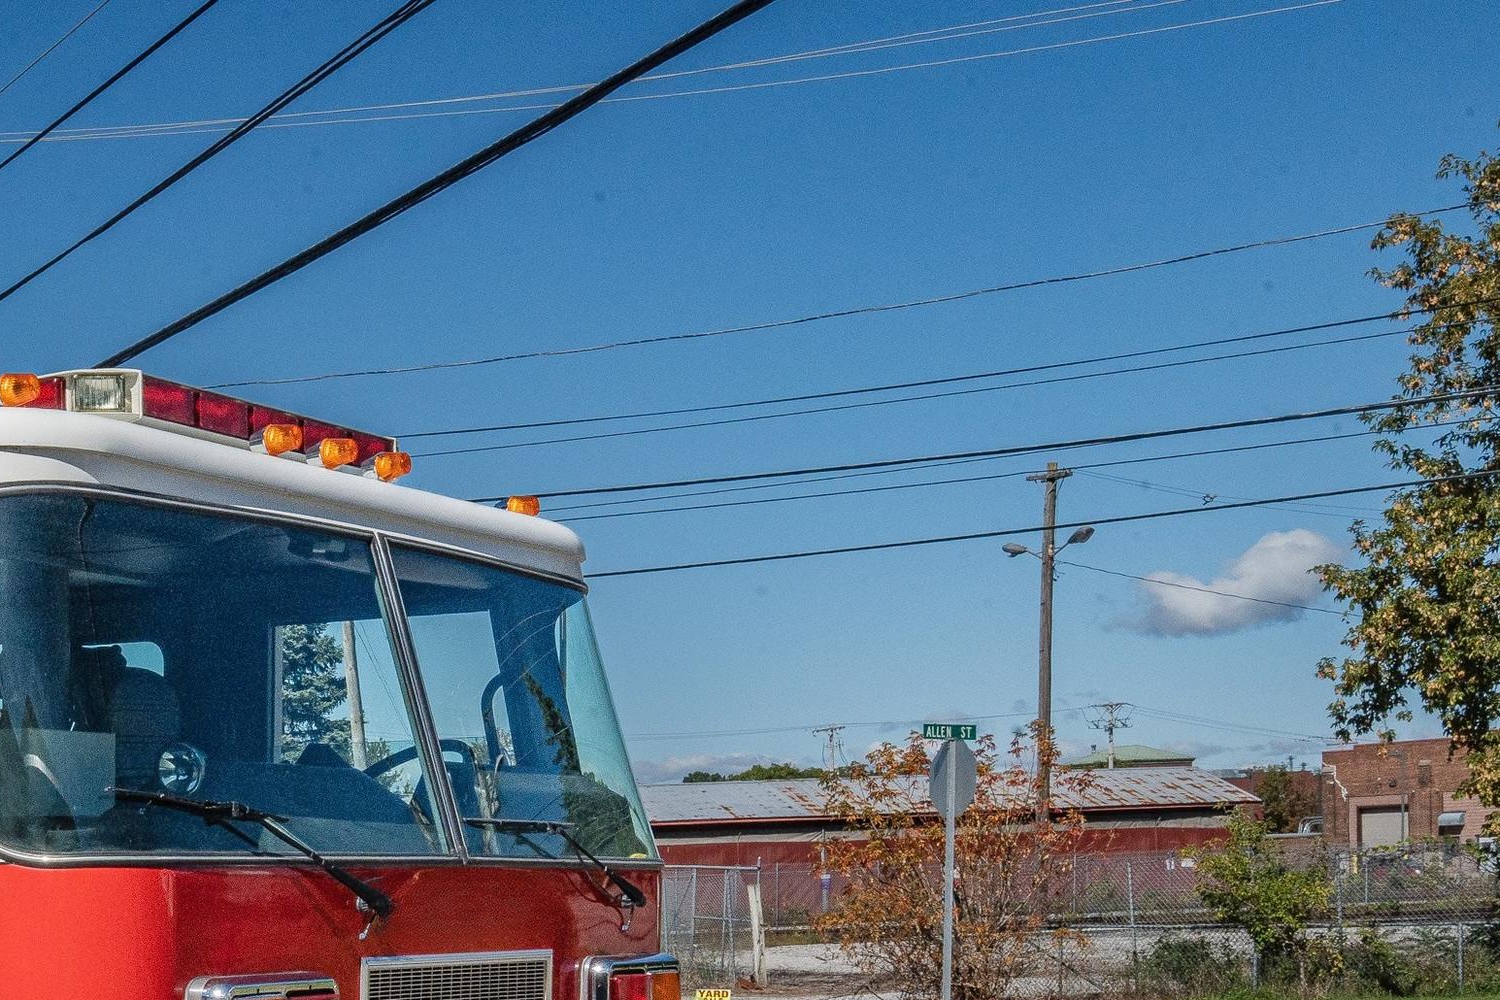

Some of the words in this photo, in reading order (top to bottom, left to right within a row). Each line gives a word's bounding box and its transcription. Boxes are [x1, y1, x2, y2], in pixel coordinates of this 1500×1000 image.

[925, 726, 952, 738] ALLEN
[960, 726, 972, 739] ST
[698, 990, 729, 998] YARD
